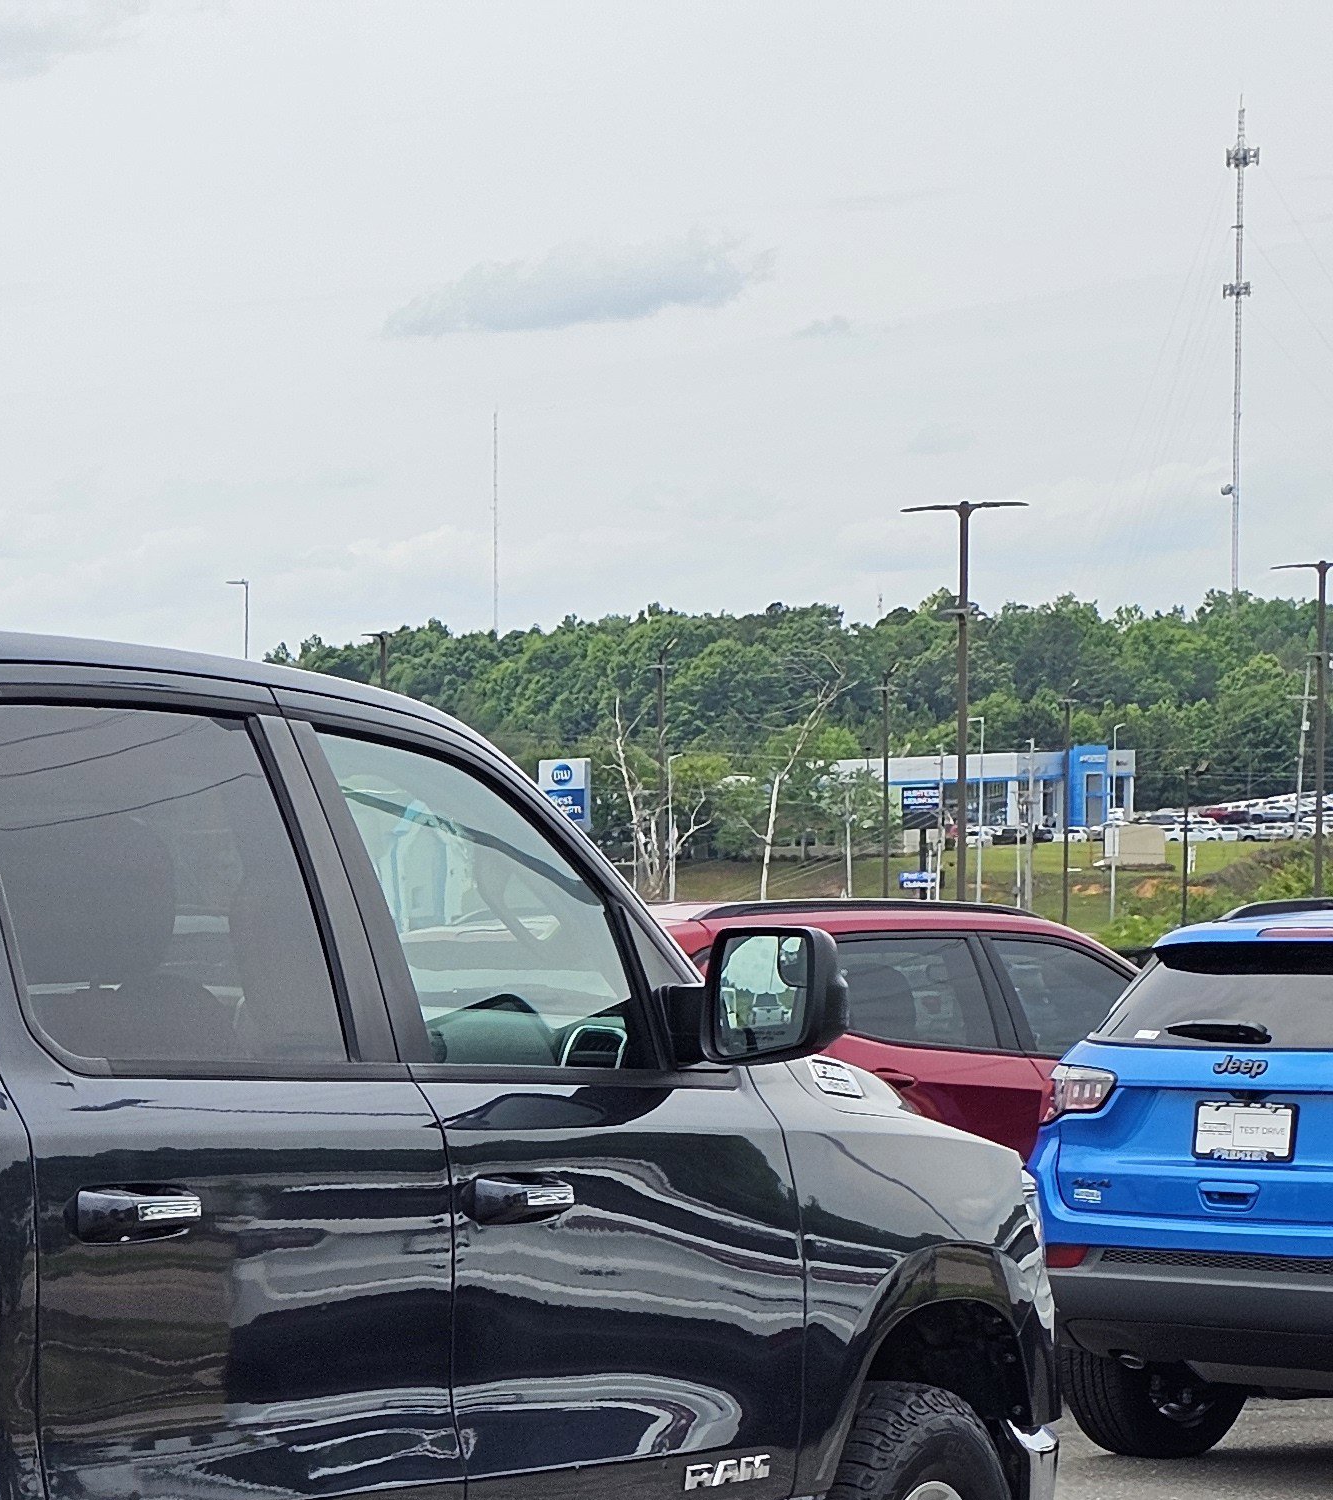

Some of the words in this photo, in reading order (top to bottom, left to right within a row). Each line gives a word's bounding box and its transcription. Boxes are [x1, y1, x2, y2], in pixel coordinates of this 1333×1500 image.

[1213, 1055, 1268, 1078] Jeep
[1239, 1126, 1259, 1134] TEST
[1262, 1127, 1285, 1135] DRIVE
[684, 1454, 770, 1491] RAM
